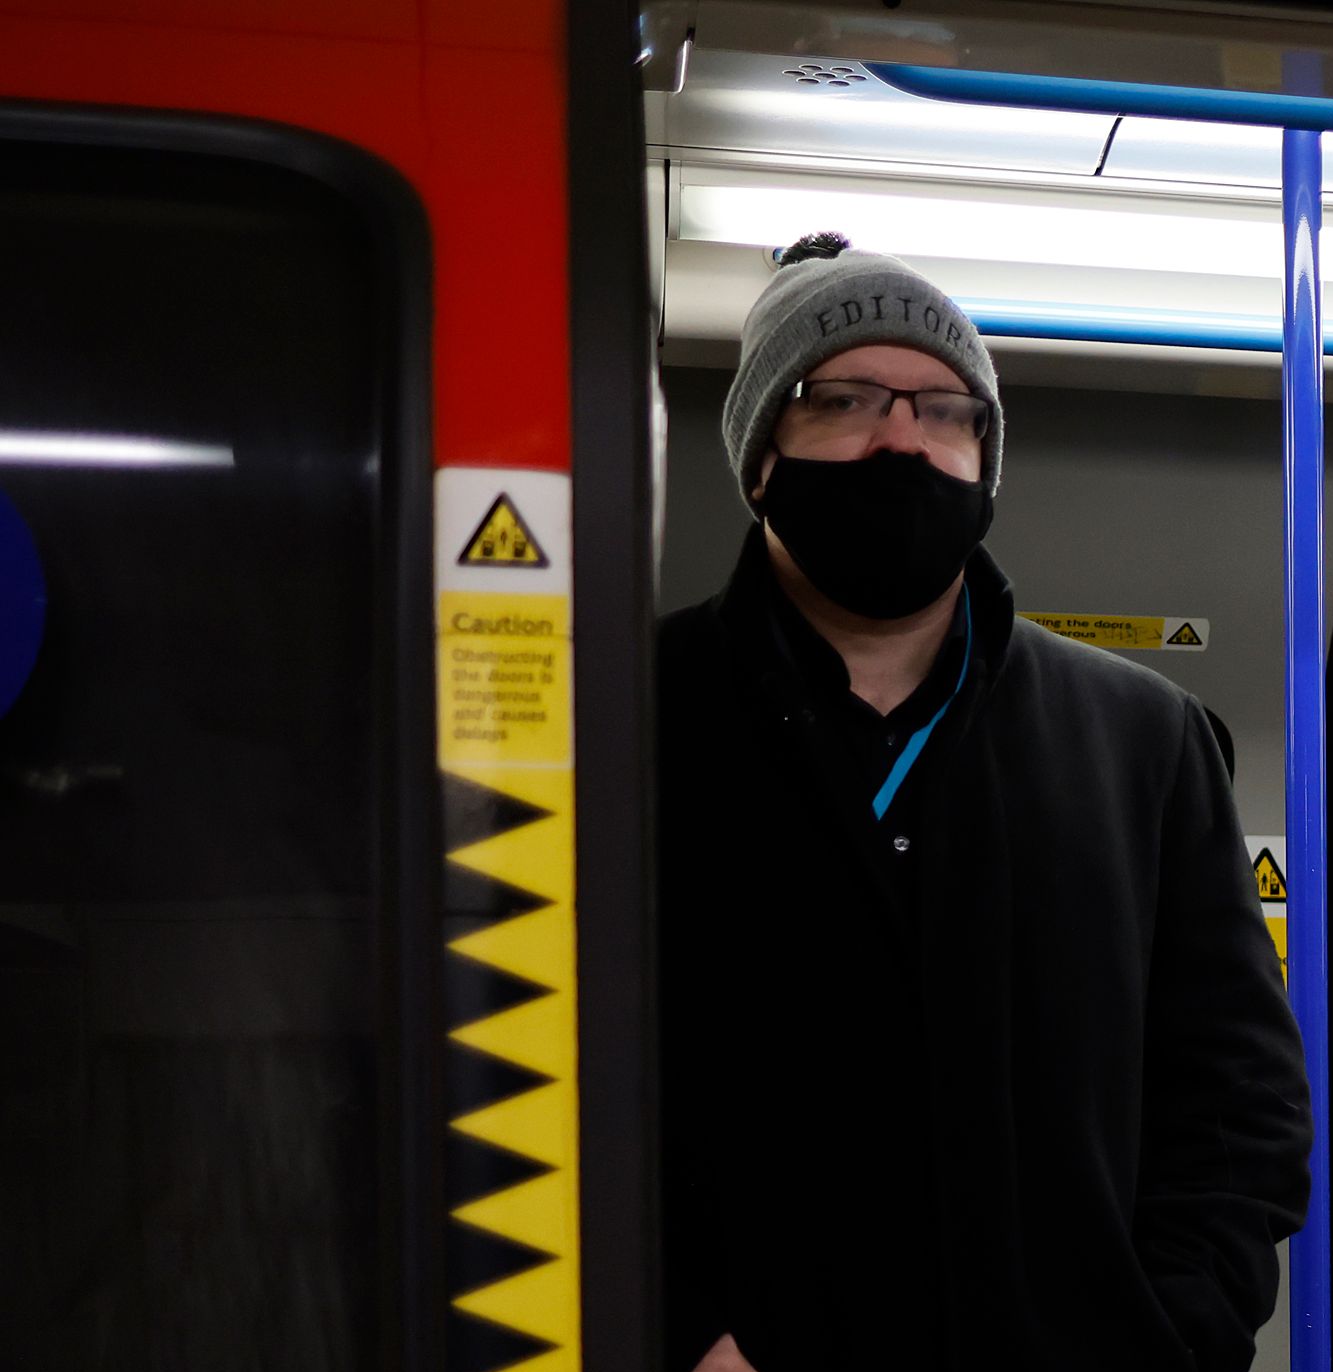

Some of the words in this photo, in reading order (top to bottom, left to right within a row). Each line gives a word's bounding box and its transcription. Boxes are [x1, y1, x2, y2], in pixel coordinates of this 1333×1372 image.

[452, 612, 553, 635] Caution
[1066, 619, 1089, 627] the
[1094, 620, 1132, 629] doors
